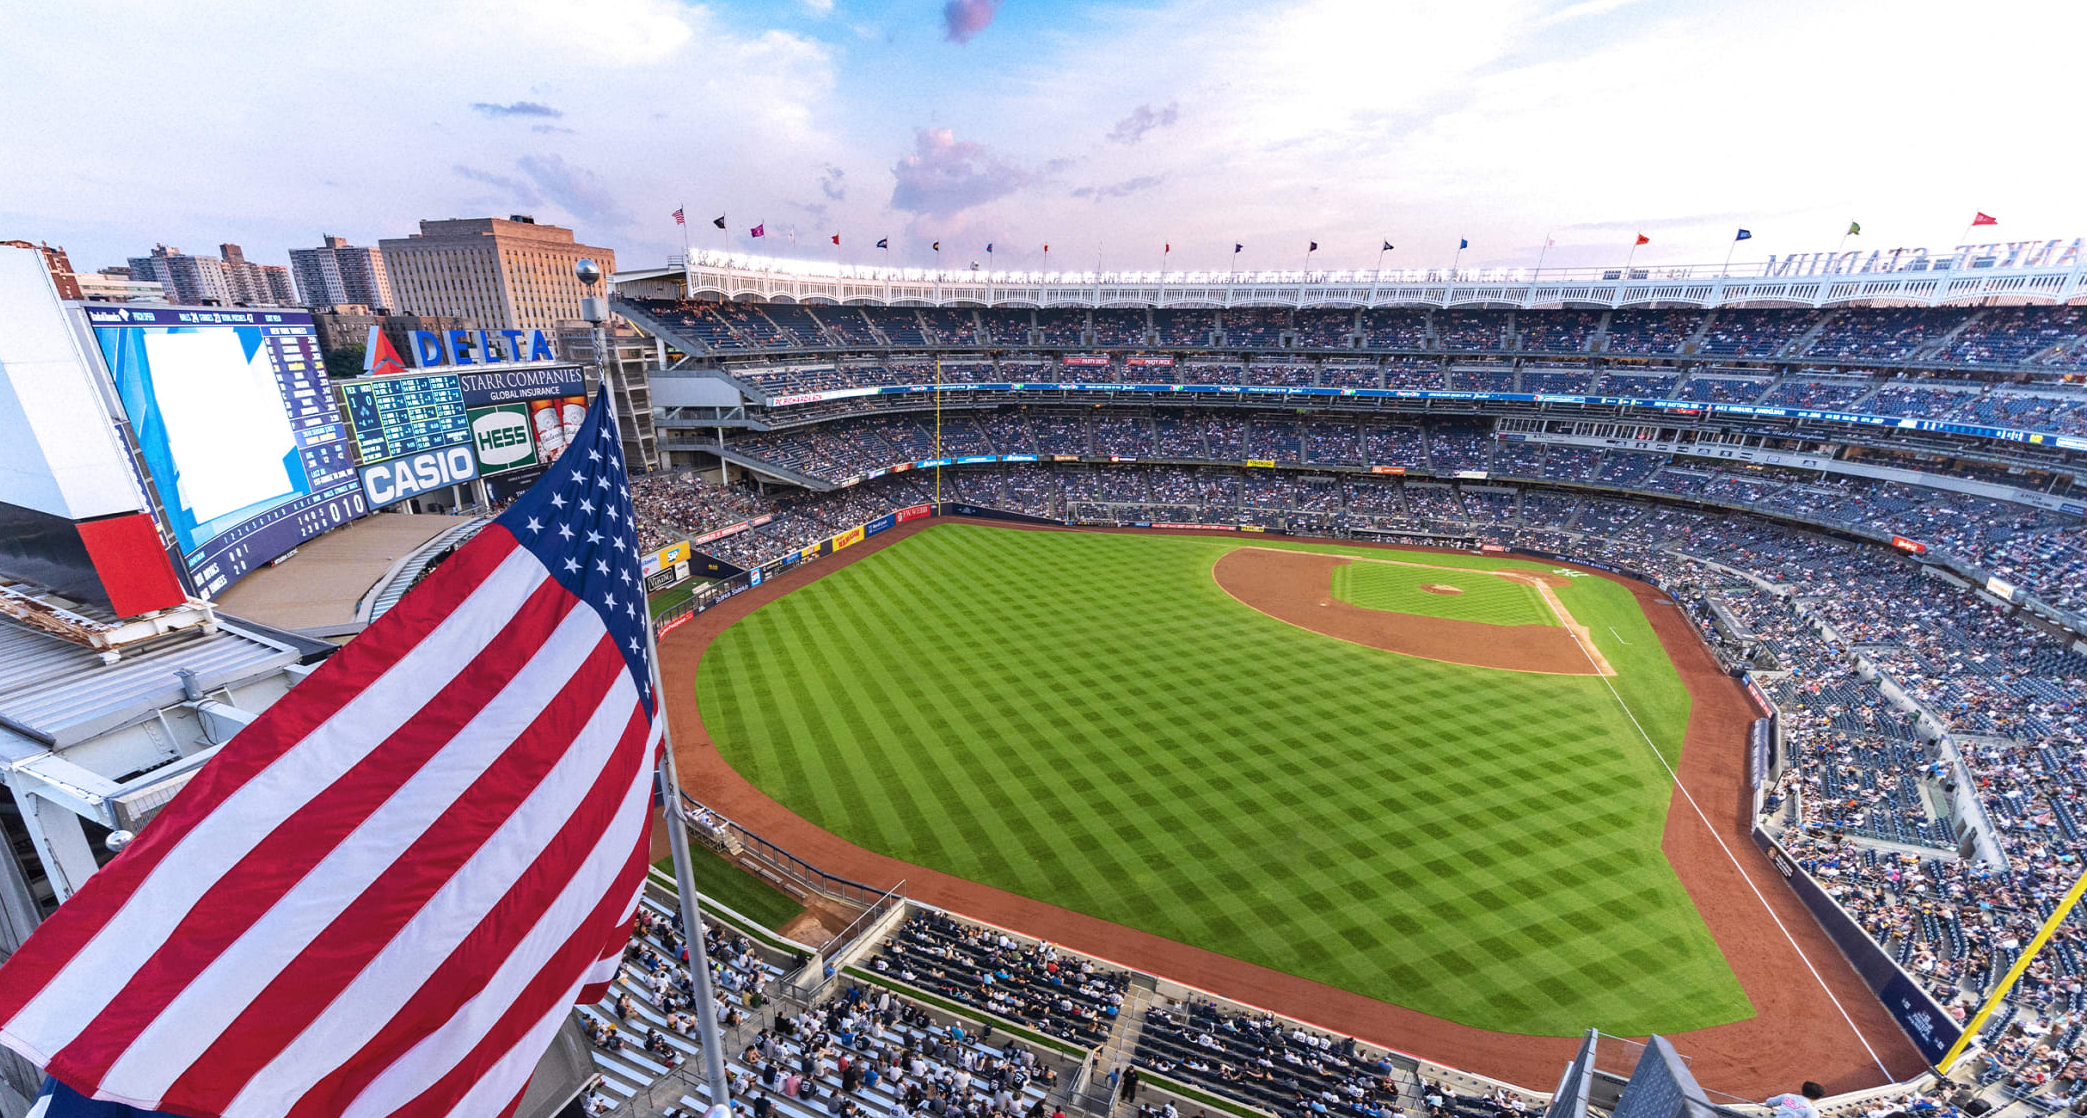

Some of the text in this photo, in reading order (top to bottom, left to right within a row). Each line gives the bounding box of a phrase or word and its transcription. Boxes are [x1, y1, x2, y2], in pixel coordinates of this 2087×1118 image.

[408, 329, 554, 367] DELTA
[461, 368, 582, 392] STARR COMPANIES
[490, 386, 561, 400] GLOBAL INSURANCE
[478, 425, 527, 451] HESS
[364, 446, 475, 504] CASIO
[329, 494, 364, 522] 0 1 0
[668, 550, 679, 562] SAP
